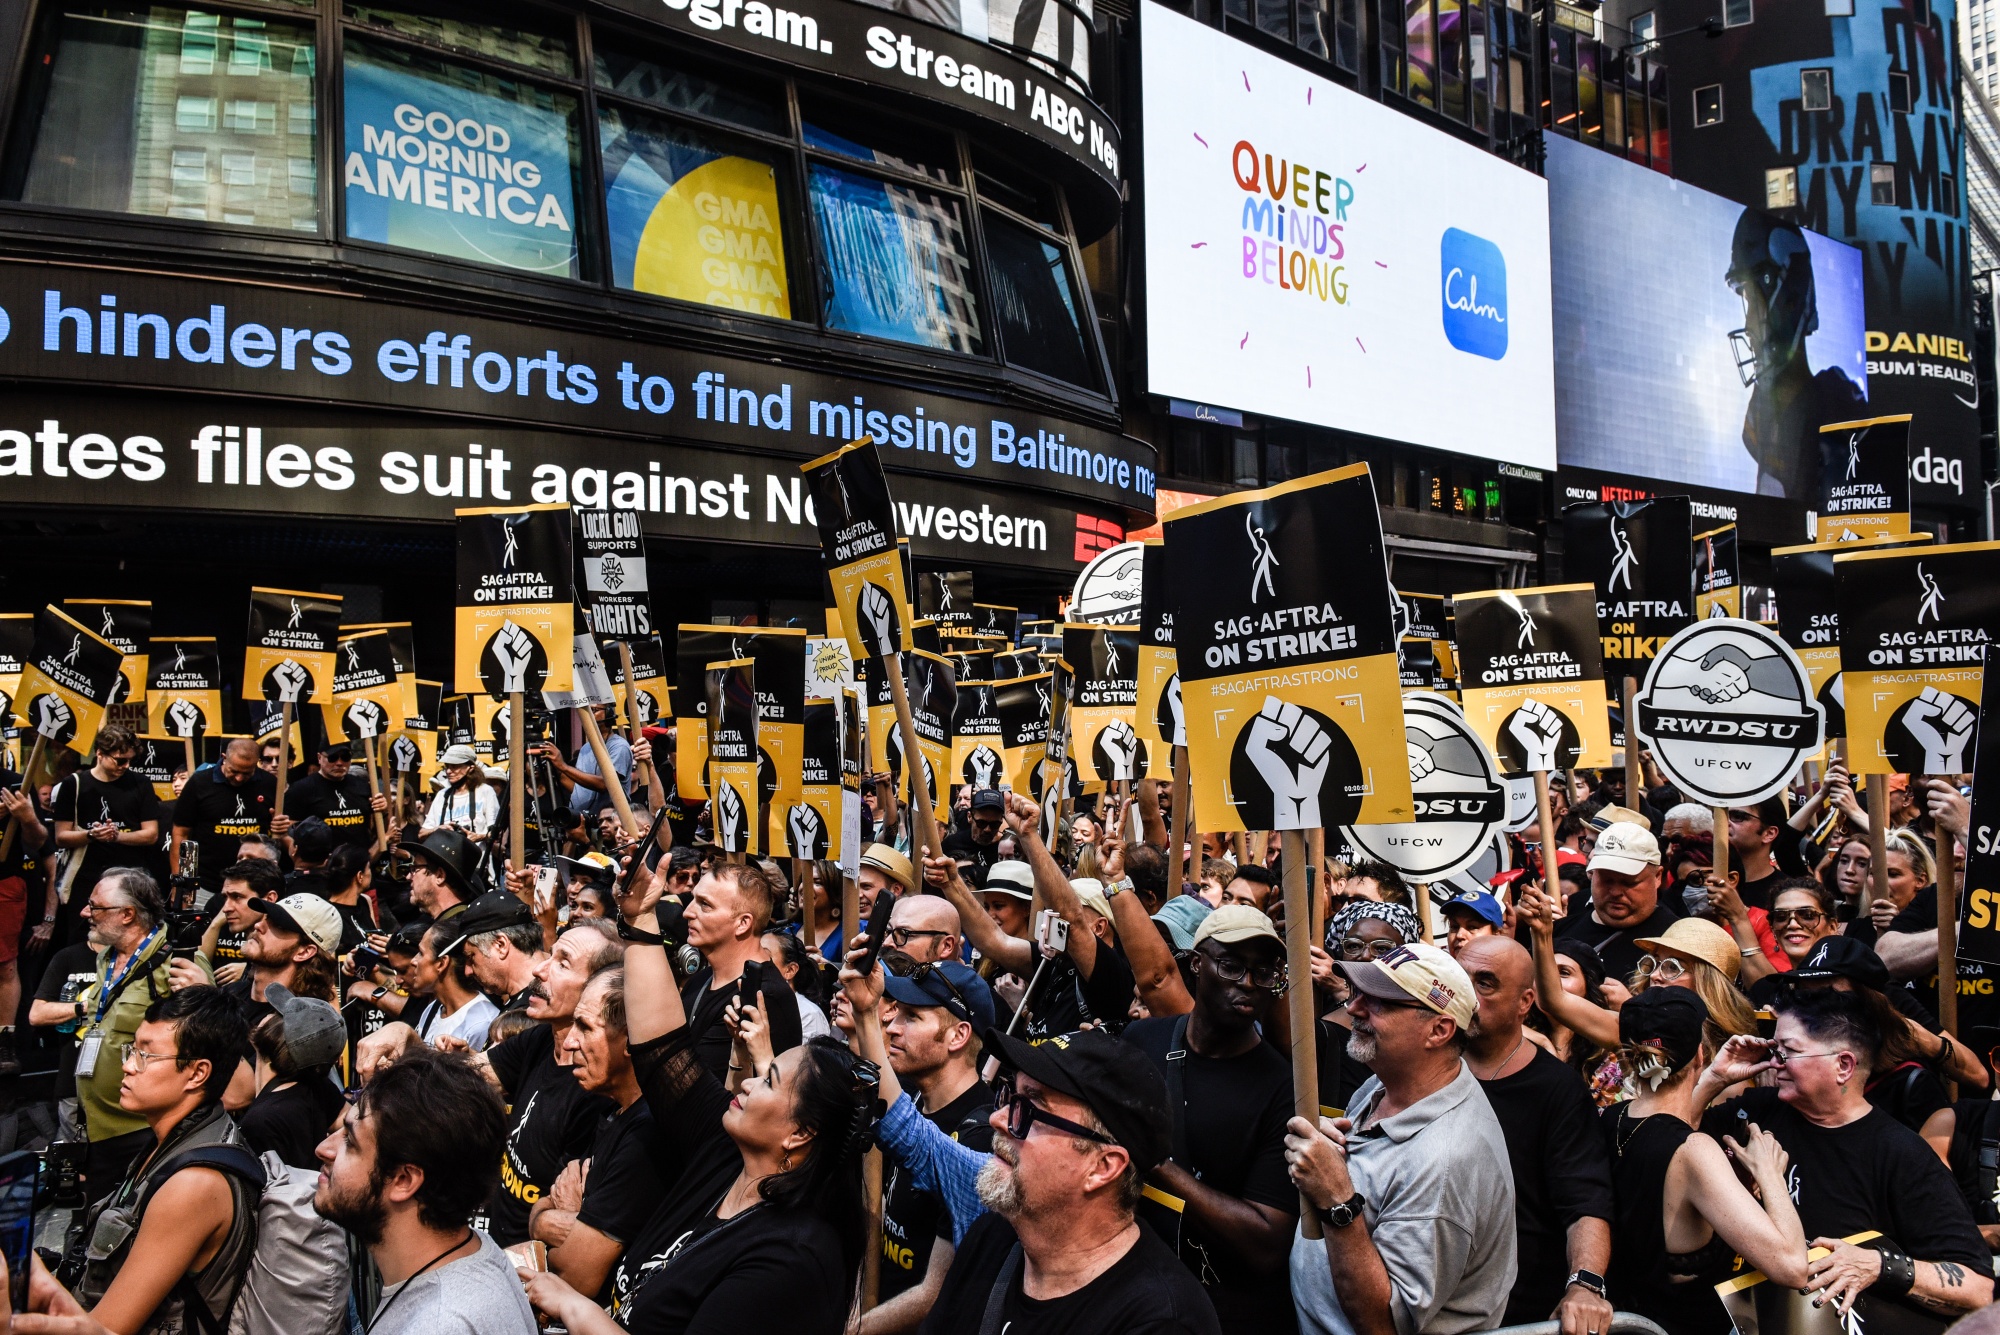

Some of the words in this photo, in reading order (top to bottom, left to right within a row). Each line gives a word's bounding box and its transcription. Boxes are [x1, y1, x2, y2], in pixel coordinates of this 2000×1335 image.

[866, 26, 1015, 110] Stream
[1026, 79, 1085, 145] 'ABC
[394, 103, 510, 153] GOOD
[363, 124, 541, 188] MORNING
[1232, 140, 1355, 222] QUEER
[345, 152, 570, 232] AMERICA
[694, 192, 774, 234] GMA
[697, 225, 778, 266] GMA
[702, 258, 782, 299] GMA
[1445, 267, 1505, 323] Calm
[1865, 331, 1970, 363] DANIEL
[44, 290, 352, 376] hinders
[377, 332, 599, 405] efforts
[617, 361, 675, 415] to
[692, 370, 791, 432] find
[809, 396, 977, 469] missing
[990, 420, 1128, 488] Baltimore
[1195, 405, 1219, 422] Calm
[0, 420, 165, 481] ates
[191, 424, 355, 490] files
[380, 443, 511, 502] suit
[530, 461, 749, 521] against
[1908, 447, 1963, 495] daq
[1566, 486, 1585, 499] ONLY
[1585, 489, 1597, 500] ON
[1602, 485, 1646, 502] NETFLIX
[1690, 501, 1738, 521] TREAMING
[1827, 500, 1840, 512] ON
[1841, 497, 1891, 510] STRIKE!
[581, 512, 613, 539] LOCAL
[613, 511, 639, 538] 600
[1826, 517, 1889, 527] #SAGAFTRASTRONG
[587, 540, 637, 550] SUPPORTS
[1074, 513, 1128, 563] ES
[835, 544, 851, 561] ON
[474, 588, 497, 602] ON
[498, 585, 553, 600] STRIKE!
[475, 607, 552, 618] #SAGAFTRASTRONG
[1595, 600, 1689, 618] G·AFTRA.
[591, 603, 650, 635] RIGHTS
[936, 627, 973, 638] RIKE!
[1154, 627, 1173, 642] ON
[1611, 623, 1635, 635] ON
[1802, 629, 1830, 644] ON
[261, 637, 280, 646] ON
[281, 639, 324, 649] STRIKE!
[1204, 643, 1241, 668] ON
[1246, 624, 1357, 662] STRIKE!
[1600, 637, 1670, 659] RIK
[819, 654, 837, 664] UNION
[1868, 648, 1903, 665] ON
[1909, 644, 1985, 664] STRIK
[819, 662, 838, 672] PROUD
[1482, 669, 1511, 683] ON
[1513, 663, 1582, 681] STRIKE!
[40, 660, 52, 676] ON
[53, 671, 96, 698] STRIKE!
[156, 680, 171, 688] ON
[171, 680, 209, 688] STRIKE!
[331, 681, 346, 693] ON
[347, 674, 386, 690] STRIKE!
[615, 674, 625, 683] ON
[632, 669, 657, 680] TRIKE!
[1211, 666, 1359, 697] #SAGAFTRASTRONG
[1872, 671, 1983, 684] #SAGAFTRASTRO
[879, 690, 890, 702] ON
[1081, 692, 1101, 703] ON
[1103, 690, 1137, 703] STRIK
[1485, 685, 1581, 699] #SAGAFTRASTRONG
[258, 727, 268, 736] ON
[268, 720, 284, 733] STRI
[1655, 716, 1800, 740] RWDSU
[1017, 732, 1036, 744] ON
[1695, 758, 1752, 771] UFCW
[1413, 799, 1487, 816] DSU
[324, 815, 364, 827] STRONG
[215, 825, 261, 836] STRONG
[1388, 837, 1443, 847] UFCW
[76, 972, 97, 982] PUB
[1432, 979, 1456, 999] 9-11-01
[501, 1151, 541, 1204] RONG
